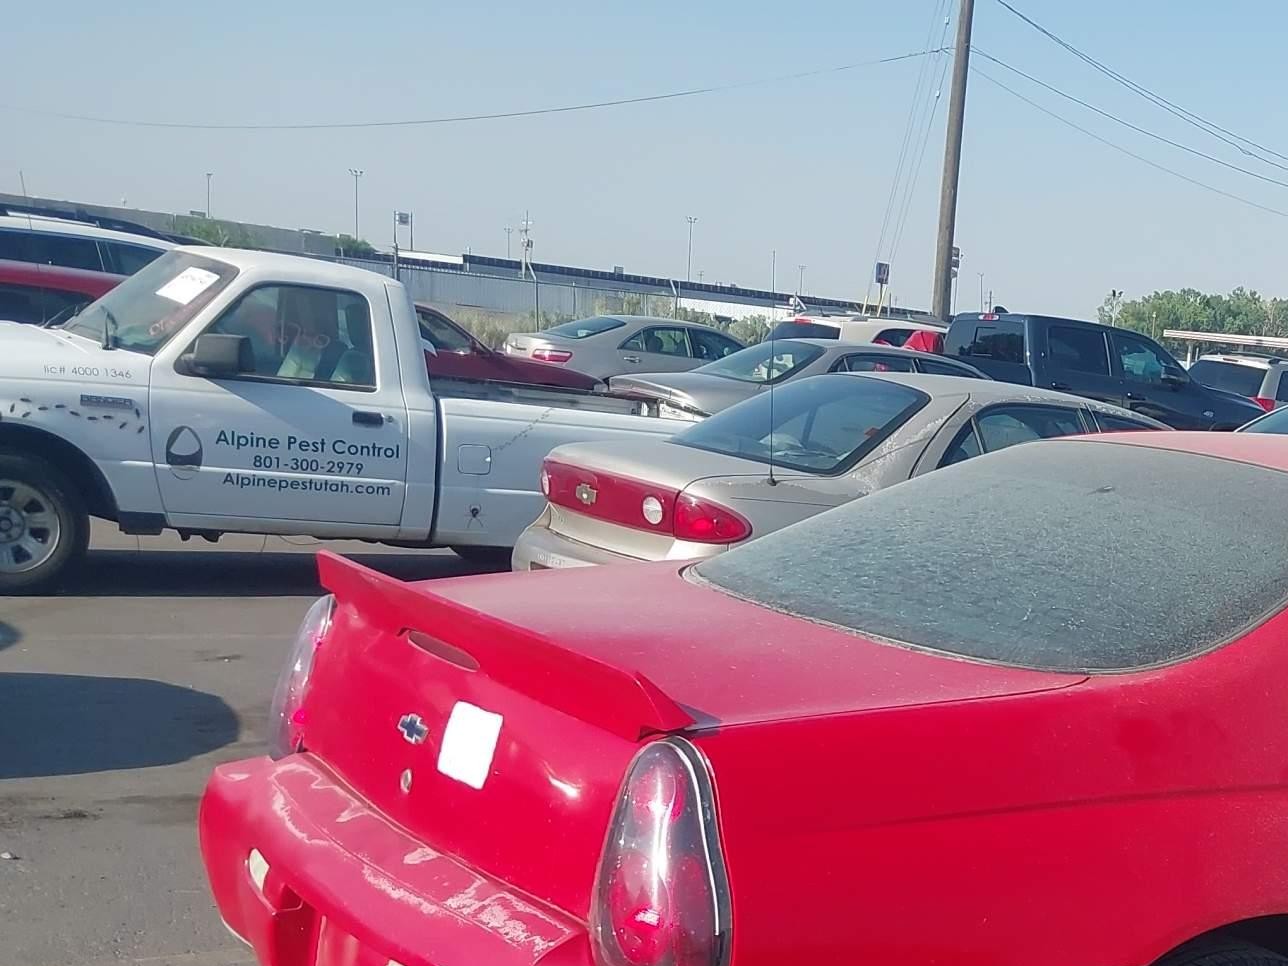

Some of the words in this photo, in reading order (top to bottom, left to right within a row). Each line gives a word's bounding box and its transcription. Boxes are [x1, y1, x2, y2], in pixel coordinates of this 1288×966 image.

[71, 366, 100, 377] 4000
[105, 367, 133, 379] 1346
[215, 429, 280, 450] Alpine
[287, 435, 325, 453] Pest
[332, 439, 400, 459] Control
[252, 454, 364, 475] 801-300-2979
[222, 472, 392, 496] Alpinepestutah.com
